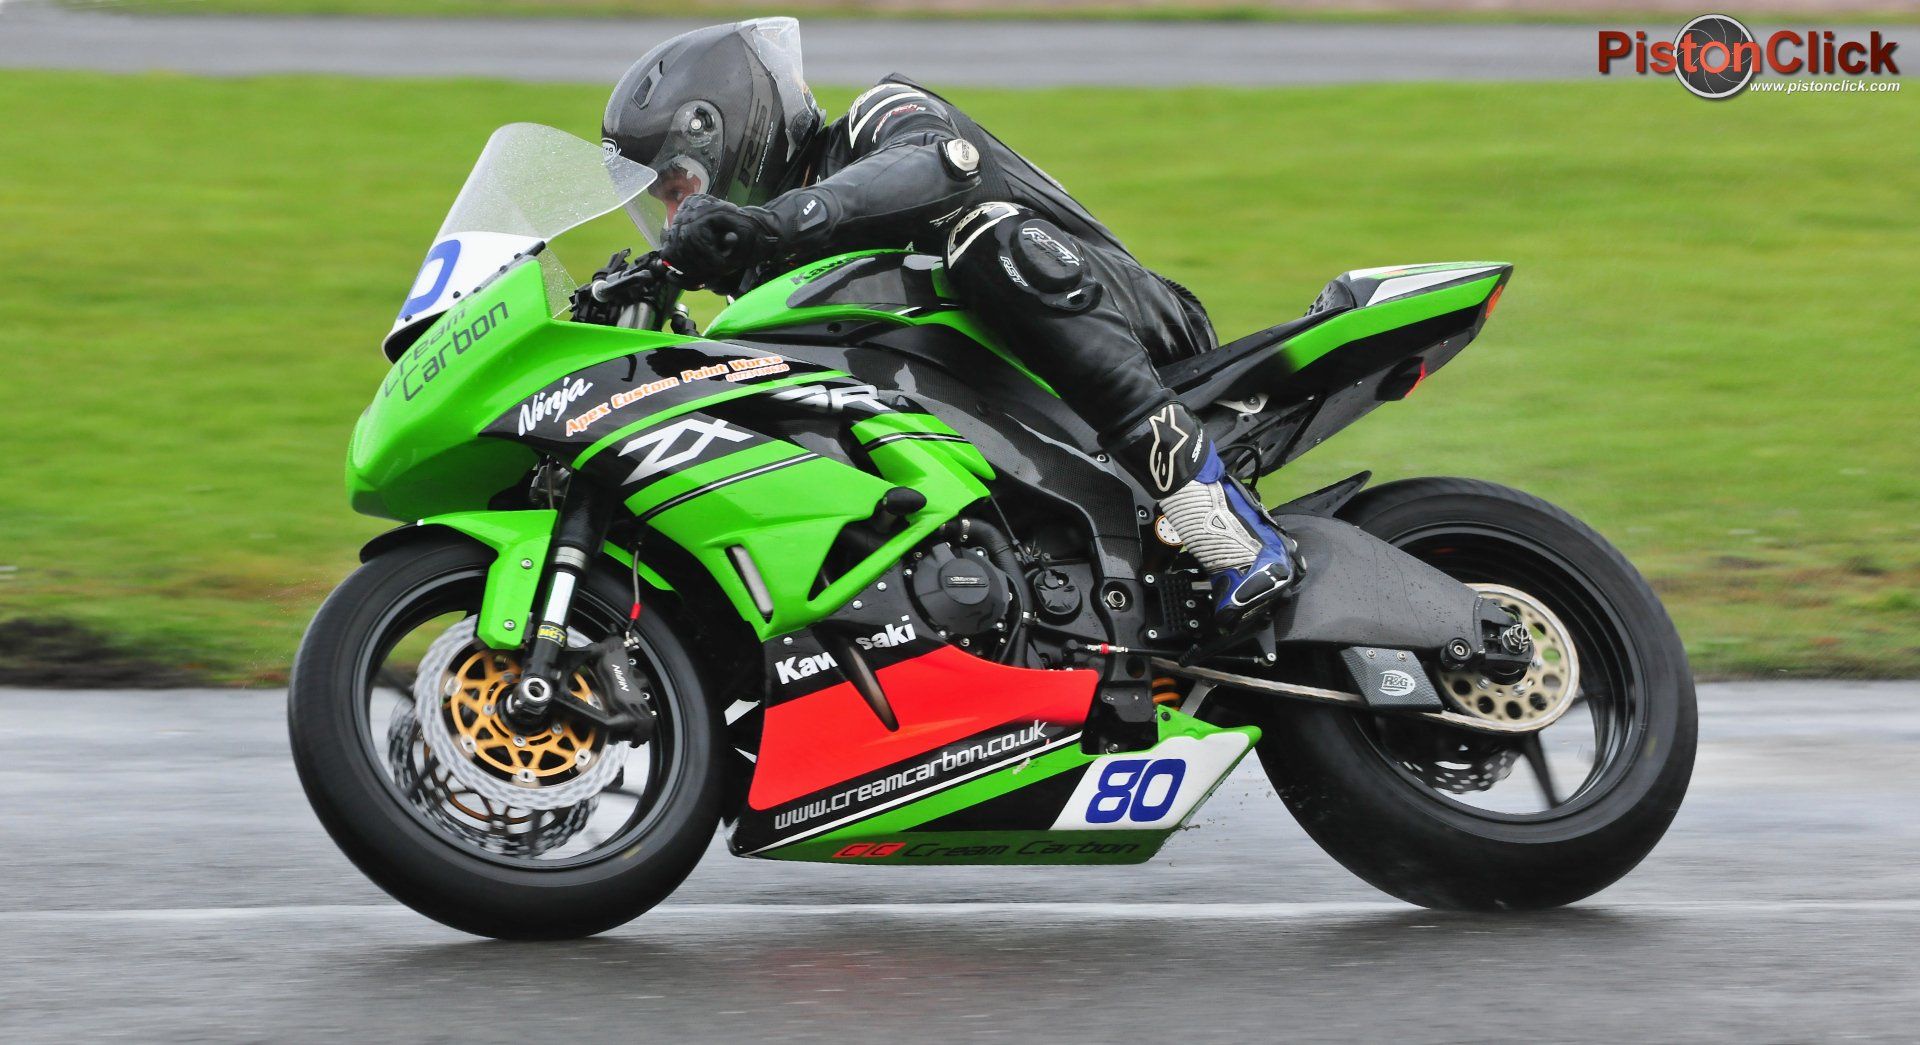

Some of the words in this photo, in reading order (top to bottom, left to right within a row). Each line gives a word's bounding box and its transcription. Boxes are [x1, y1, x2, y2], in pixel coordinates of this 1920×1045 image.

[1000, 255, 1029, 287] RST
[1022, 227, 1080, 267] RST
[403, 301, 509, 401] Carbon
[518, 376, 594, 437] Ninja
[565, 402, 612, 437] Apex
[611, 376, 680, 409] Custom
[680, 363, 730, 383] Paint
[617, 418, 755, 487] ZX
[1384, 675, 1408, 687] R&G
[774, 719, 1048, 831] www.creamcarbon.co.uk
[1085, 758, 1187, 825] 80
[902, 842, 1009, 858] Cream
[1016, 840, 1141, 856] Carbon
